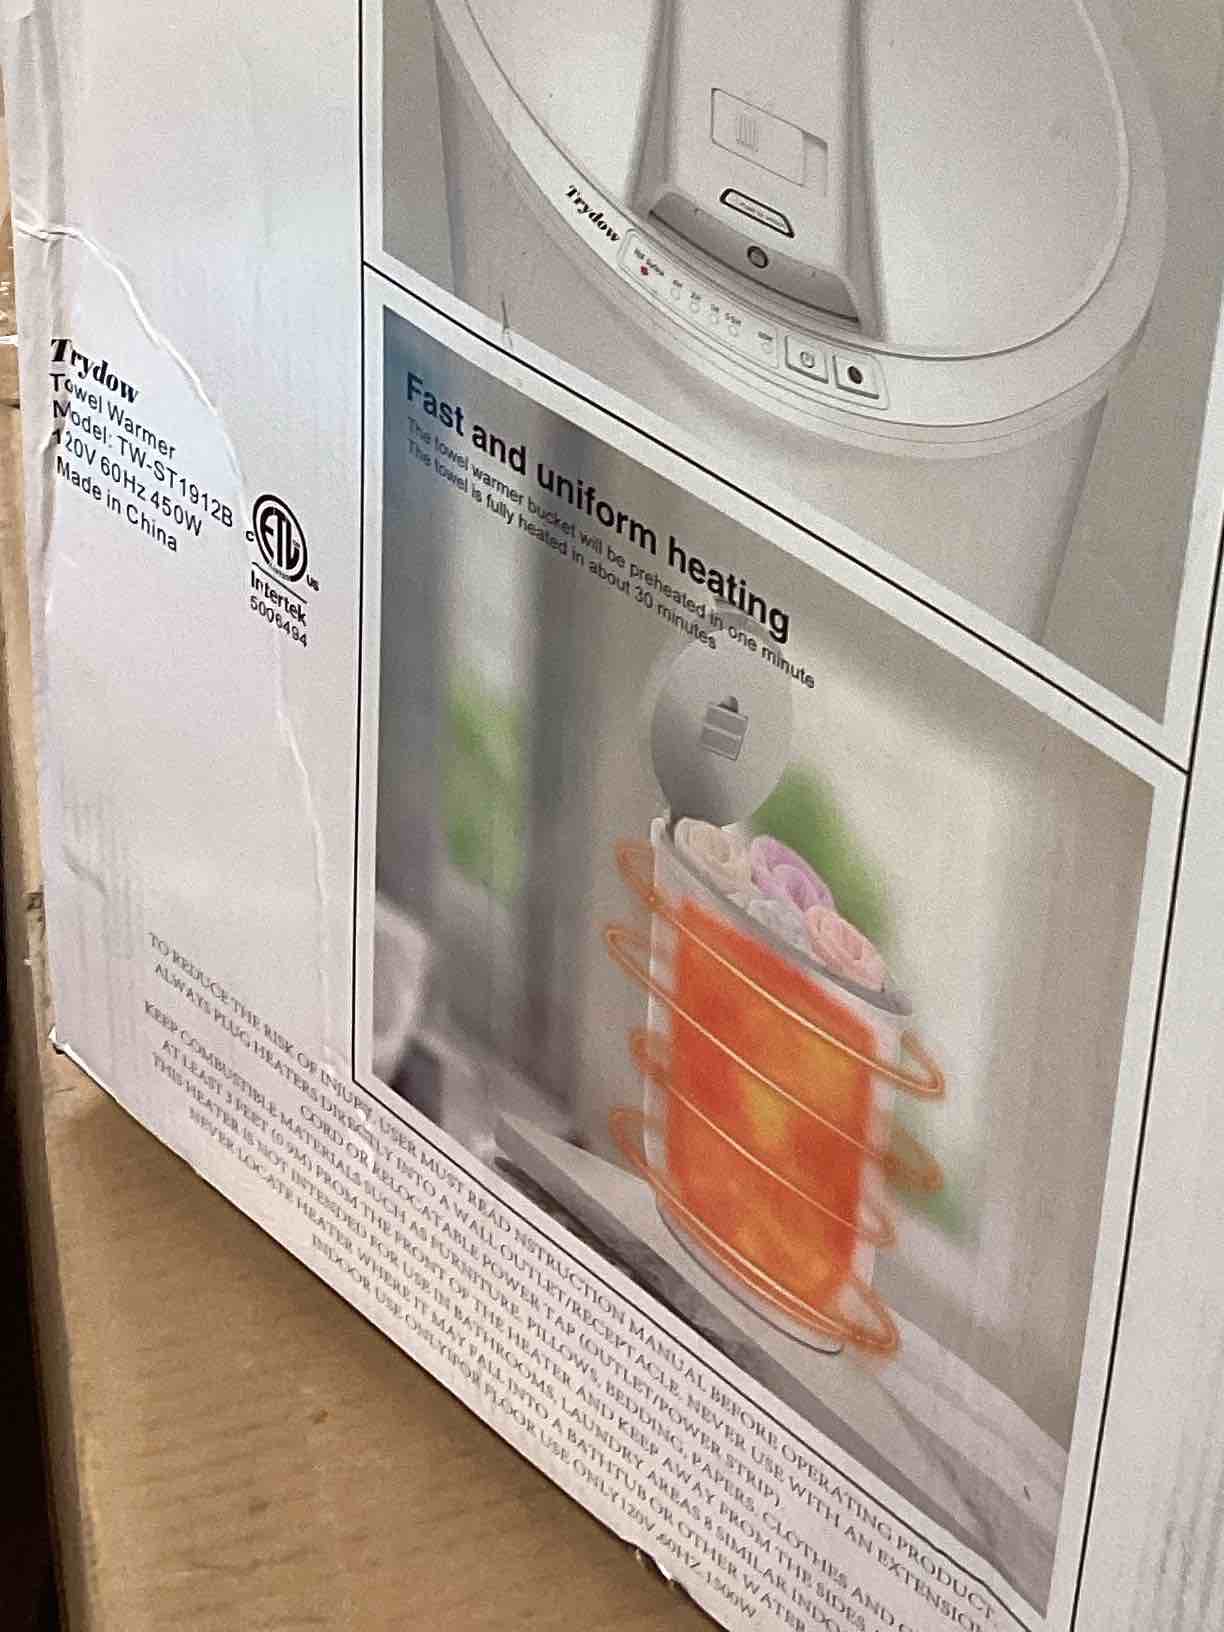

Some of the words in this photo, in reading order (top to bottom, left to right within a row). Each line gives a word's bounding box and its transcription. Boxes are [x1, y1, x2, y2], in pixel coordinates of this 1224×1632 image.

[564, 185, 621, 242] Trydow
[49, 373, 103, 415] Towel
[107, 401, 176, 459] Warmer
[51, 338, 139, 404] Trydow
[52, 428, 98, 467] 120V
[101, 456, 146, 501] 60Hz
[151, 486, 202, 536] 450W
[53, 399, 114, 450] Model:
[117, 435, 233, 528] TW-ST1912B
[56, 456, 102, 501] Made
[107, 487, 122, 517] in
[126, 504, 178, 552] China
[407, 372, 463, 436] Fast
[471, 424, 525, 475] and
[537, 463, 656, 555] uniform
[668, 535, 789, 644] heating
[407, 438, 430, 466] The
[434, 457, 468, 493] towel
[470, 479, 485, 503] is
[485, 487, 514, 524] fully
[518, 513, 567, 555] heated
[572, 549, 584, 565] in
[588, 560, 630, 595] about
[634, 584, 653, 608] 30
[655, 598, 718, 649] minutes
[407, 415, 431, 444] The
[434, 435, 469, 471] towel
[469, 464, 525, 506] warmer
[527, 495, 575, 538] bucket
[579, 530, 602, 555] will
[606, 543, 625, 568] be
[628, 559, 708, 625] preheated
[707, 605, 726, 631] in
[727, 625, 758, 653] one
[761, 646, 816, 689] minute
[250, 569, 307, 627] Intertek
[250, 595, 309, 649] 5006494
